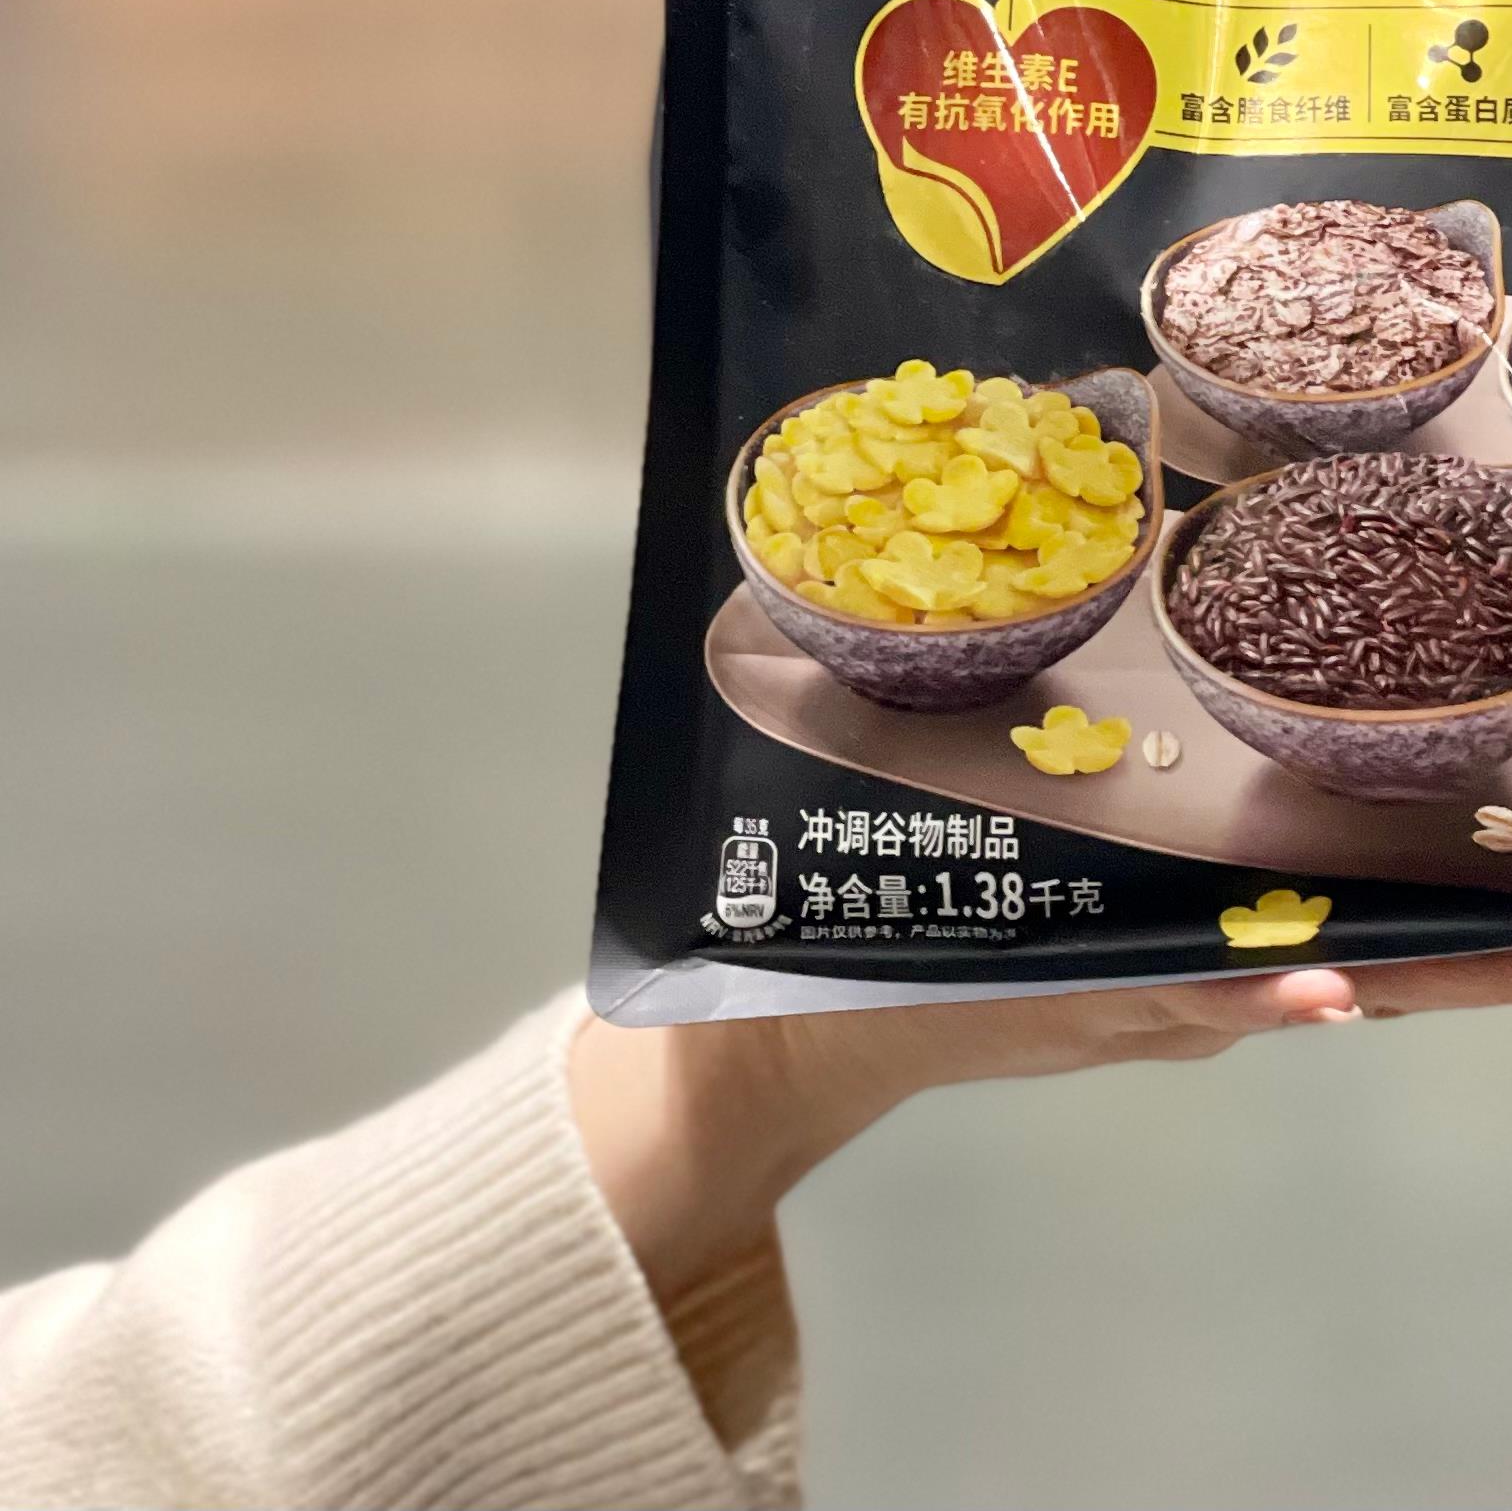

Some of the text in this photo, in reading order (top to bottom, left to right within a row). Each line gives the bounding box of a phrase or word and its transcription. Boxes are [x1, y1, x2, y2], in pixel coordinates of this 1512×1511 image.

[943, 50, 1080, 94] 维生素E
[898, 92, 1121, 139] 有抗氧化作用
[1180, 92, 1351, 126] 富含膳食纤维
[798, 807, 1020, 860] 冲调谷物制品
